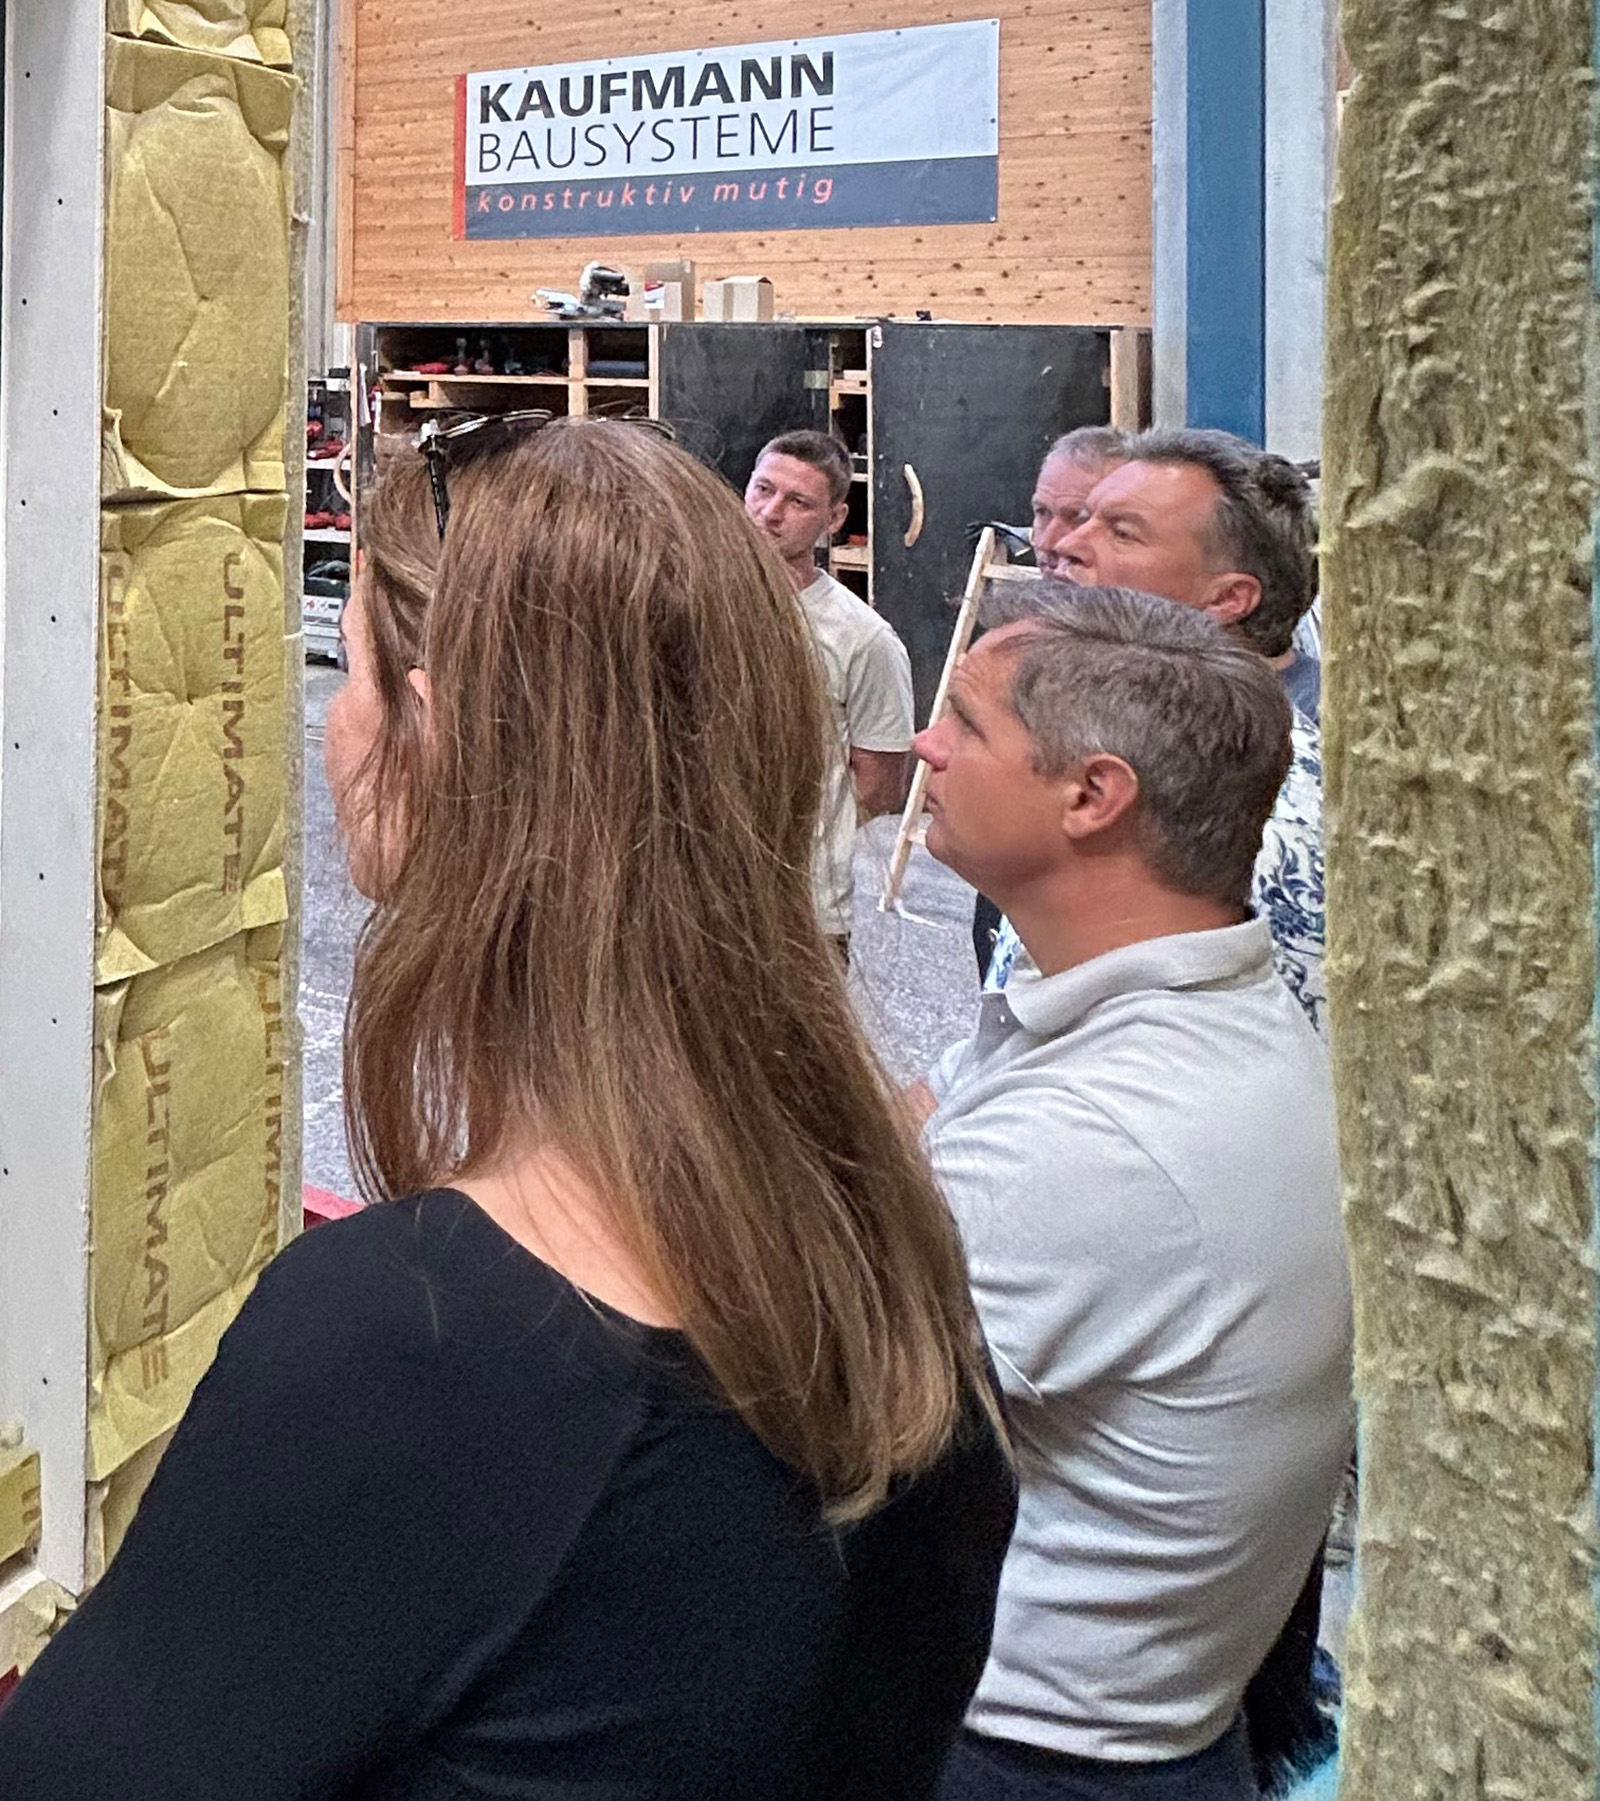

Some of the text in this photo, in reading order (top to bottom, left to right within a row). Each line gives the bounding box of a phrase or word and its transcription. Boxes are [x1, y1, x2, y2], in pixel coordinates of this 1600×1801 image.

[479, 51, 835, 124] KAUFMANN
[479, 105, 835, 174] BAUSYSTEME
[477, 173, 834, 213] konstruktiv mutig
[221, 552, 245, 896] ULTIMATE
[139, 1026, 172, 1391] ULTIMATE
